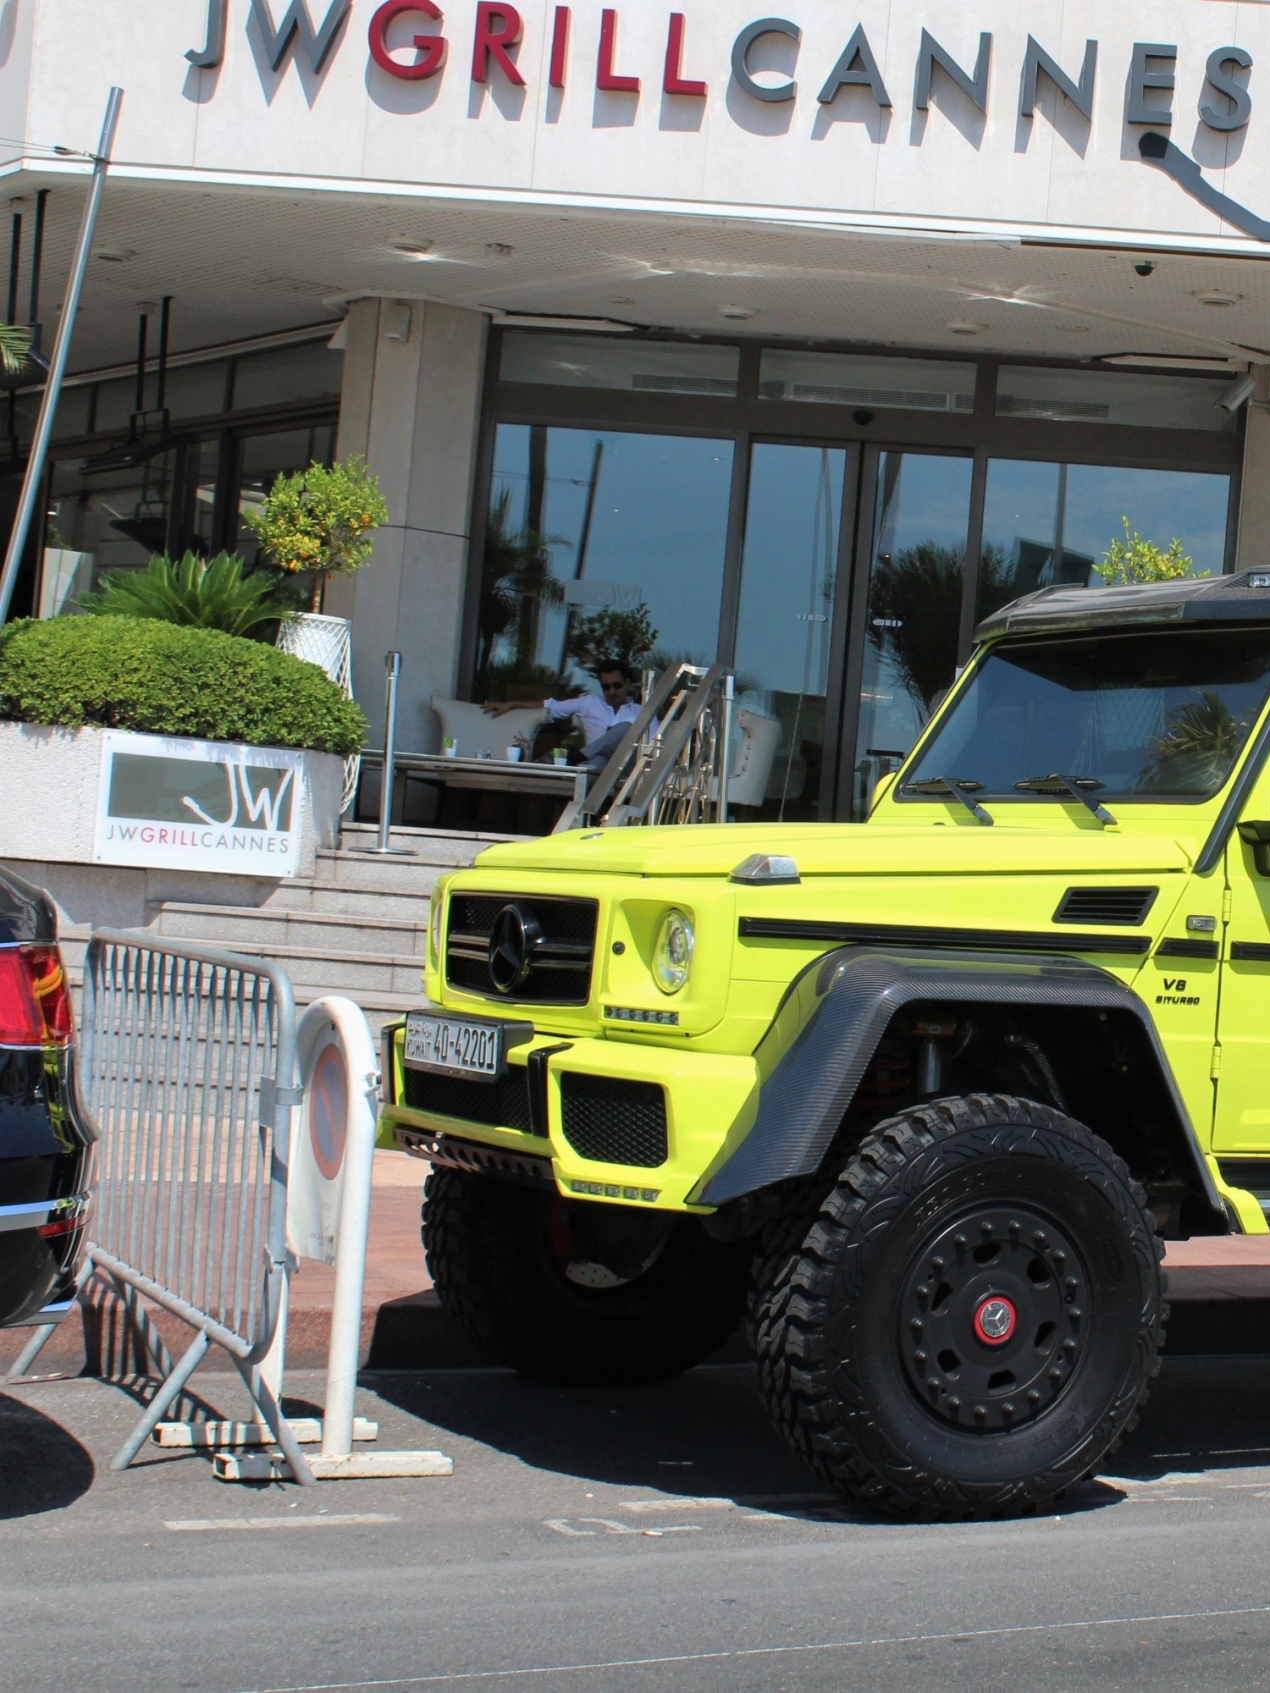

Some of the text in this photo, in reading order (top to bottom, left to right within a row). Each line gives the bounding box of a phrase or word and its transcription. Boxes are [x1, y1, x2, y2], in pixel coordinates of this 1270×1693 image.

[1163, 978, 1187, 992] V8
[1155, 995, 1200, 1006] BITURBO
[406, 1038, 432, 1060] KUWAIT
[434, 1023, 496, 1069] 40-42201
